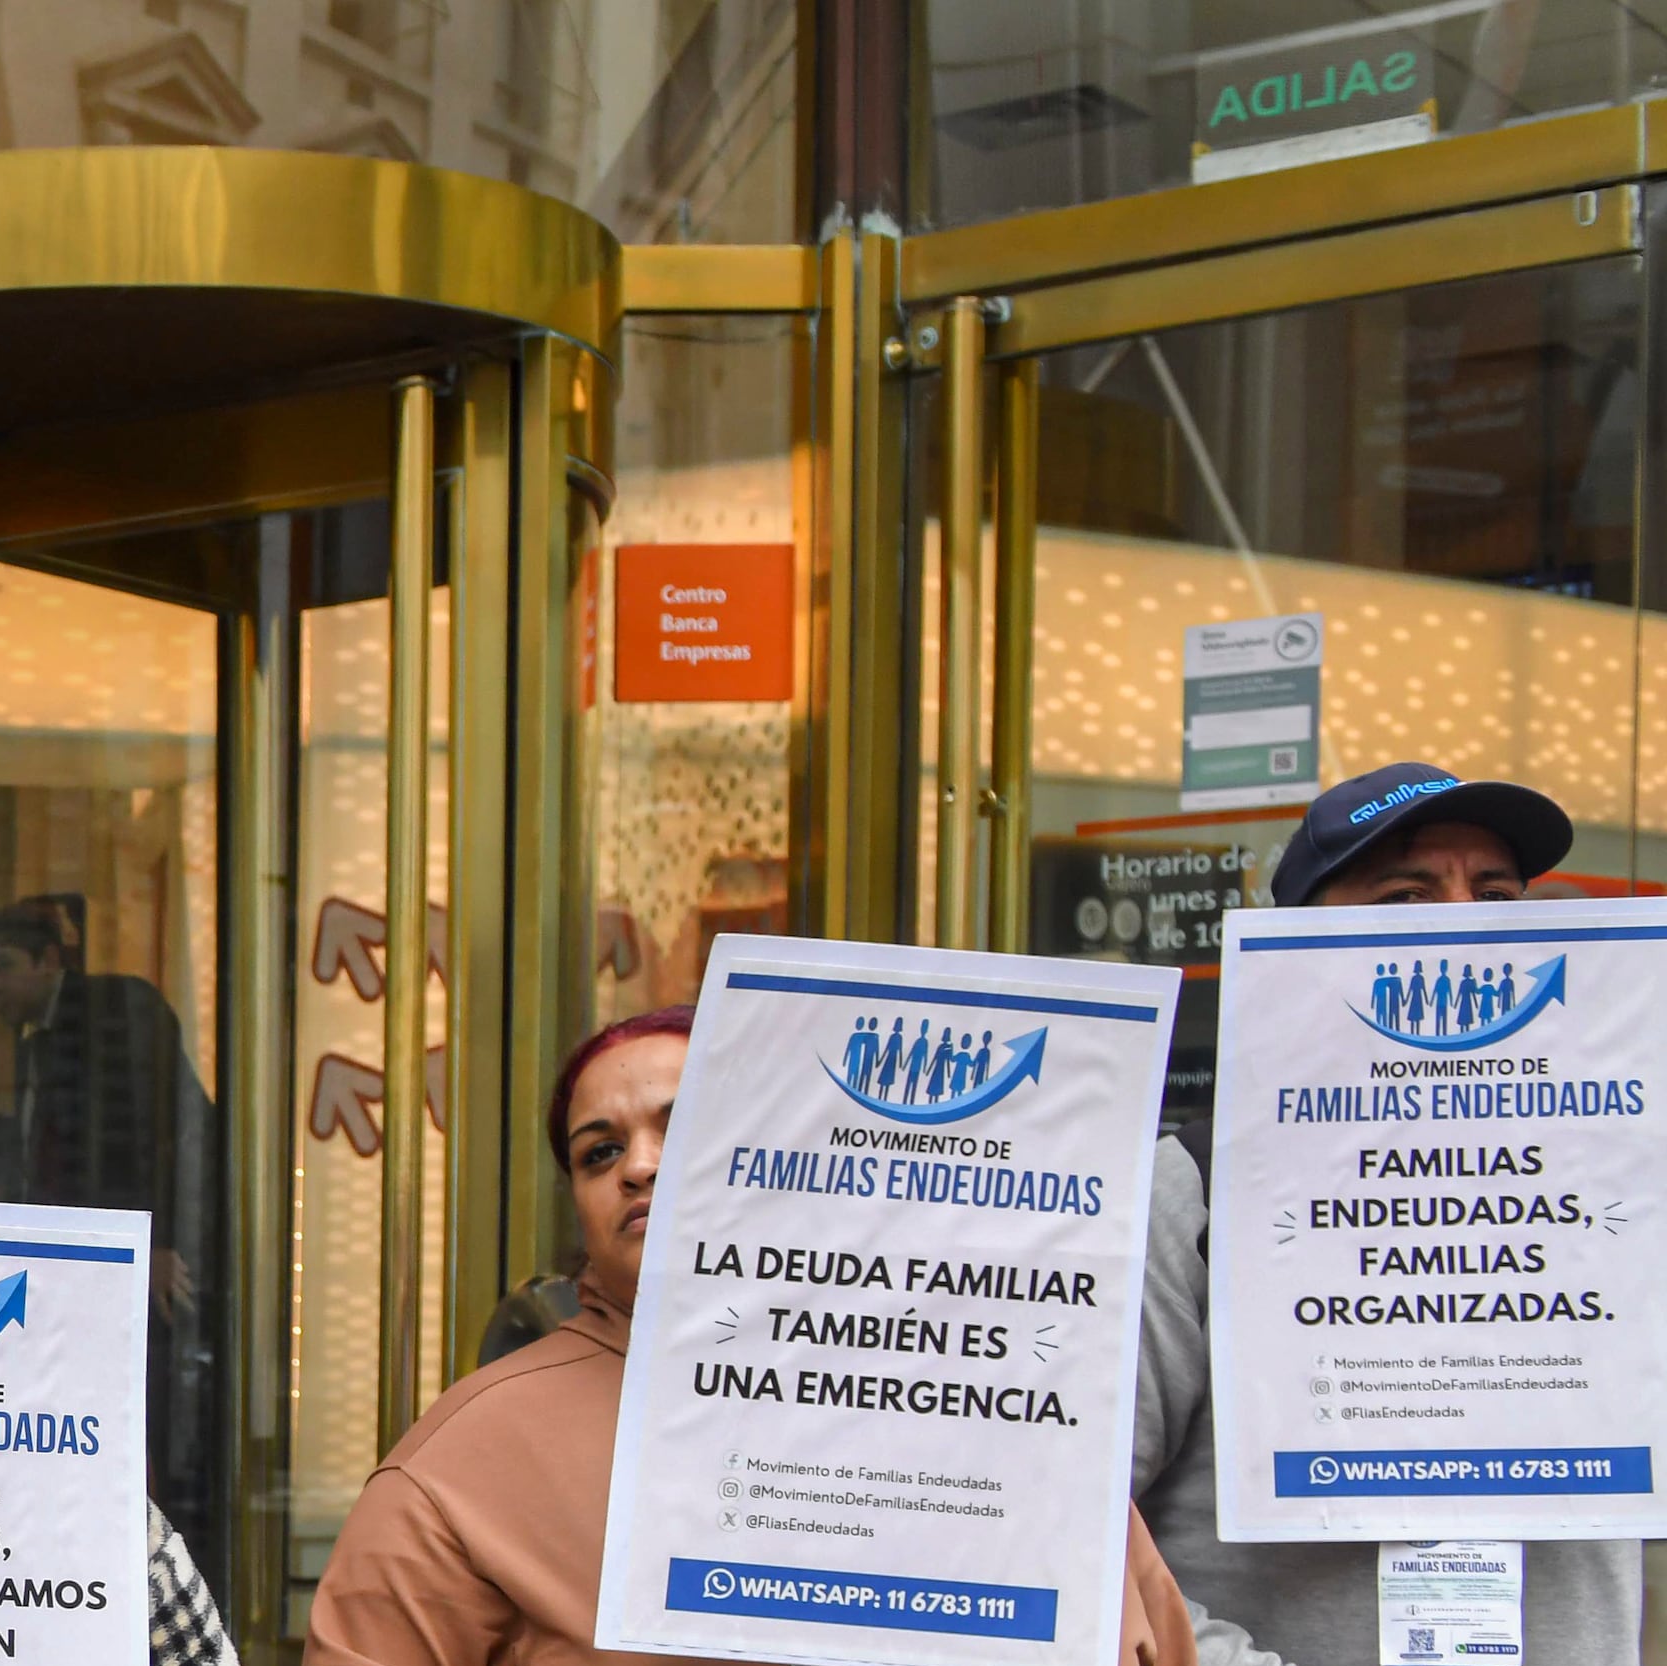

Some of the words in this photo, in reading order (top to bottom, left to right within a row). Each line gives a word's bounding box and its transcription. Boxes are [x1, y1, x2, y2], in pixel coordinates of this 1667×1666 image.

[660, 584, 727, 604] Centro
[660, 613, 719, 632] Banca
[660, 640, 752, 666] Empresas
[1100, 852, 1213, 881] Horario
[1220, 843, 1256, 870] de
[1148, 888, 1217, 913] unes
[1166, 1071, 1213, 1089] mpuje
[1369, 1058, 1515, 1079] MOVIMIENTO
[1521, 1057, 1548, 1075] DE
[1277, 1084, 1422, 1124] FAMILIAS
[1431, 1079, 1644, 1120] ENDEUDADAS
[829, 1126, 977, 1157] MOVIMIENTO
[983, 1139, 1012, 1160] DE
[1359, 1144, 1543, 1179] FAMILIAS
[727, 1146, 878, 1197] FAMILIAS
[885, 1158, 1103, 1217] ENDEUDADAS
[1310, 1193, 1593, 1229] ENDEUDADAS,
[693, 1241, 744, 1278] LA
[755, 1245, 893, 1290] DEUDA
[905, 1257, 1097, 1307] FAMILIAR
[1359, 1243, 1545, 1276] FAMILIAS
[1293, 1290, 1614, 1326] ORGANIZADAS.
[767, 1306, 949, 1355] TAMBIÉN
[960, 1323, 1008, 1360] ES
[1333, 1357, 1414, 1370] Movimiento
[1418, 1356, 1437, 1369] de
[1440, 1354, 1495, 1368] Familias
[1498, 1354, 1583, 1367] Endeudadas
[693, 1361, 784, 1402] UNA
[795, 1370, 1078, 1427] EMERGENCIA.
[1339, 1376, 1589, 1394] @MovimientoDeFamiliasEndeudadas
[1340, 1405, 1465, 1420] @FliasEndeudadas
[746, 1457, 830, 1477] Movimiento
[834, 1465, 854, 1479] de
[857, 1466, 913, 1484] Familias
[917, 1471, 1002, 1492] Endeudadas
[1342, 1460, 1480, 1480] WHATSAPP:
[1485, 1460, 1504, 1479] 11
[1508, 1459, 1570, 1479] 6783
[1573, 1459, 1611, 1478] 1111
[748, 1484, 1005, 1518] @MovimientoDeFamiliasEndeudadas
[745, 1514, 874, 1538] @FliasEndeudadas
[1392, 1561, 1439, 1572] FAMILIAS
[1443, 1562, 1507, 1574] ENDEUDADAS
[739, 1576, 881, 1608] WHATSAPP:
[887, 1589, 906, 1610] 11
[910, 1591, 972, 1616] 6783
[977, 1596, 1015, 1620] 1111
